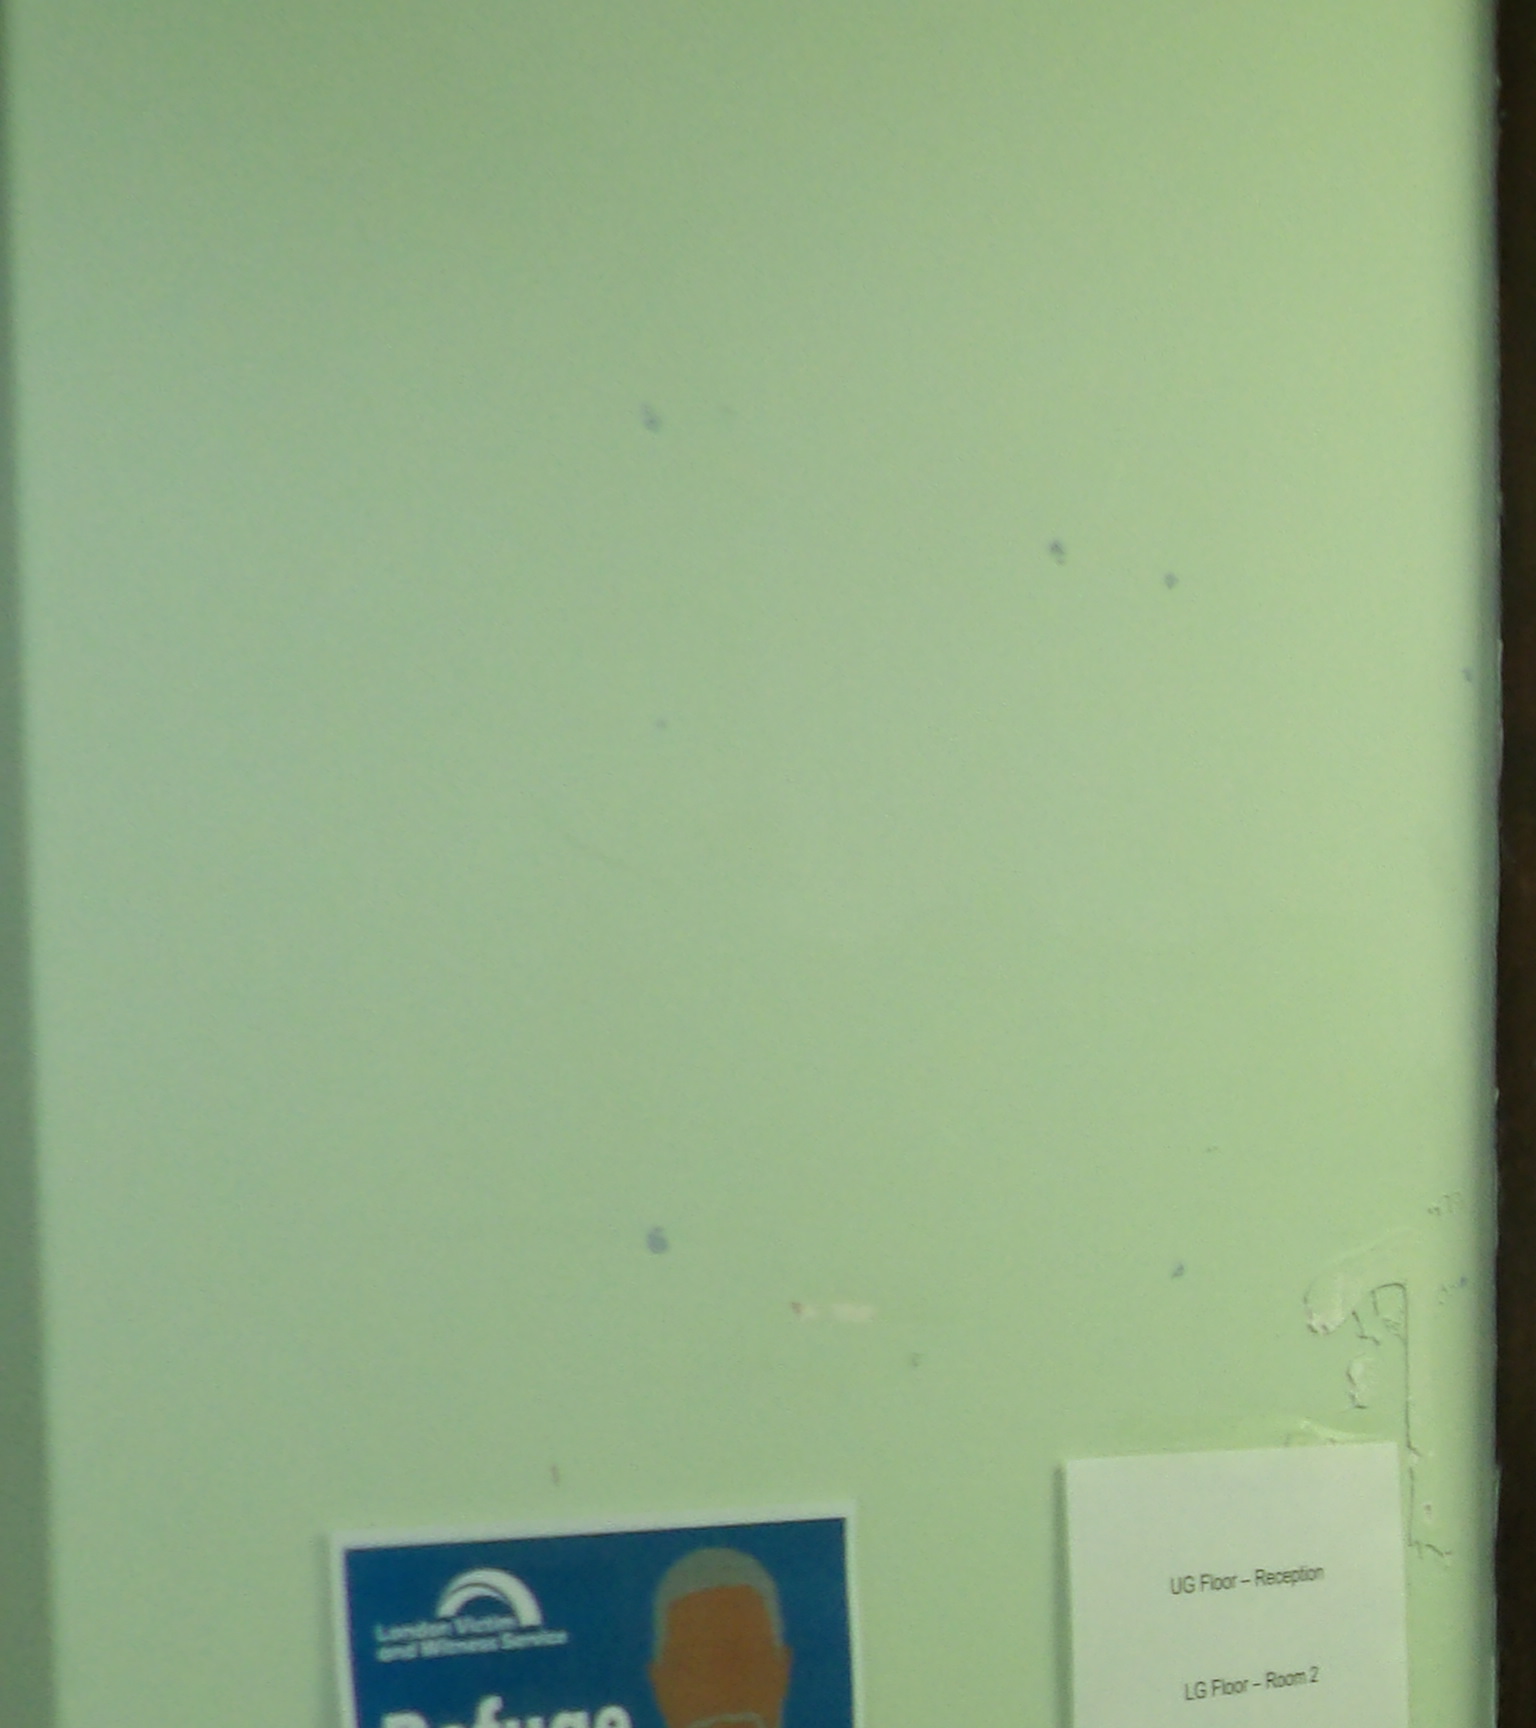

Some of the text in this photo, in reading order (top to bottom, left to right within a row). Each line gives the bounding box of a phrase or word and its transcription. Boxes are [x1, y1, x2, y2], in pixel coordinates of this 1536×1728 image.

[1170, 1574, 1196, 1595] UG
[1200, 1573, 1238, 1592] Floor
[1255, 1565, 1325, 1587] Reception
[1185, 1680, 1207, 1701] LG
[1211, 1678, 1249, 1697] Floor
[1266, 1671, 1306, 1690] Room
[1309, 1666, 1320, 1684] 2
